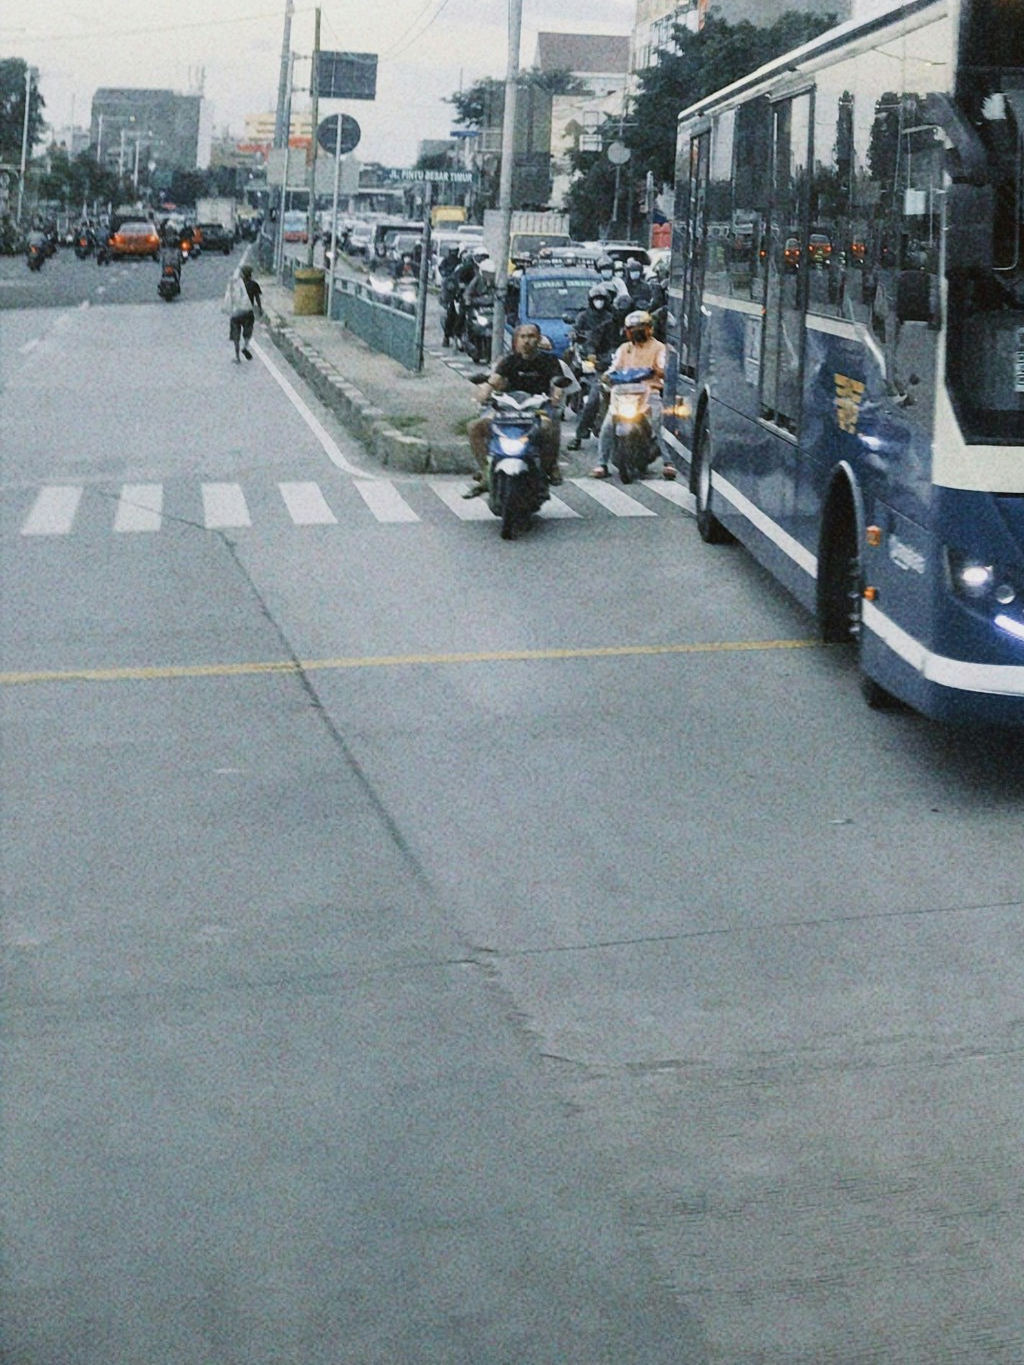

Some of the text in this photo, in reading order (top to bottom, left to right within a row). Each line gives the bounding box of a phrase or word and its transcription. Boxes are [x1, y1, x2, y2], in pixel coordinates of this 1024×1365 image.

[401, 169, 424, 181] PINTU
[425, 170, 449, 181] BESAR
[450, 172, 473, 183] TIMUR
